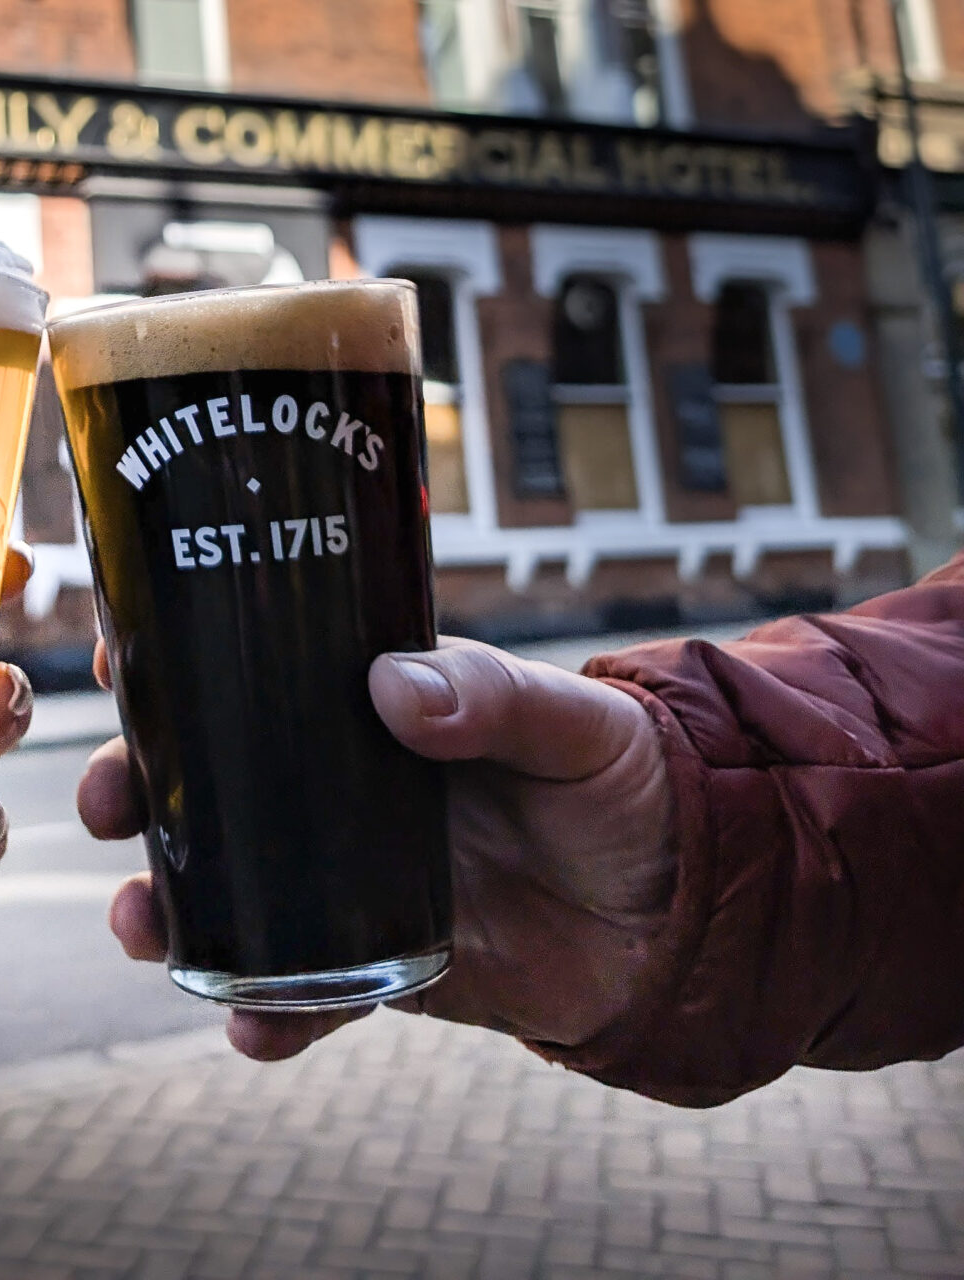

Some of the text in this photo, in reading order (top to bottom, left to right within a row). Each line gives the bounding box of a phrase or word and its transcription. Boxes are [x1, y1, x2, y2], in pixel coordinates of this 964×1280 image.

[106, 100, 162, 160] &
[173, 105, 615, 188] COMMERCIAL
[115, 394, 385, 493] WHITELOCK'S
[270, 514, 350, 562] 1715
